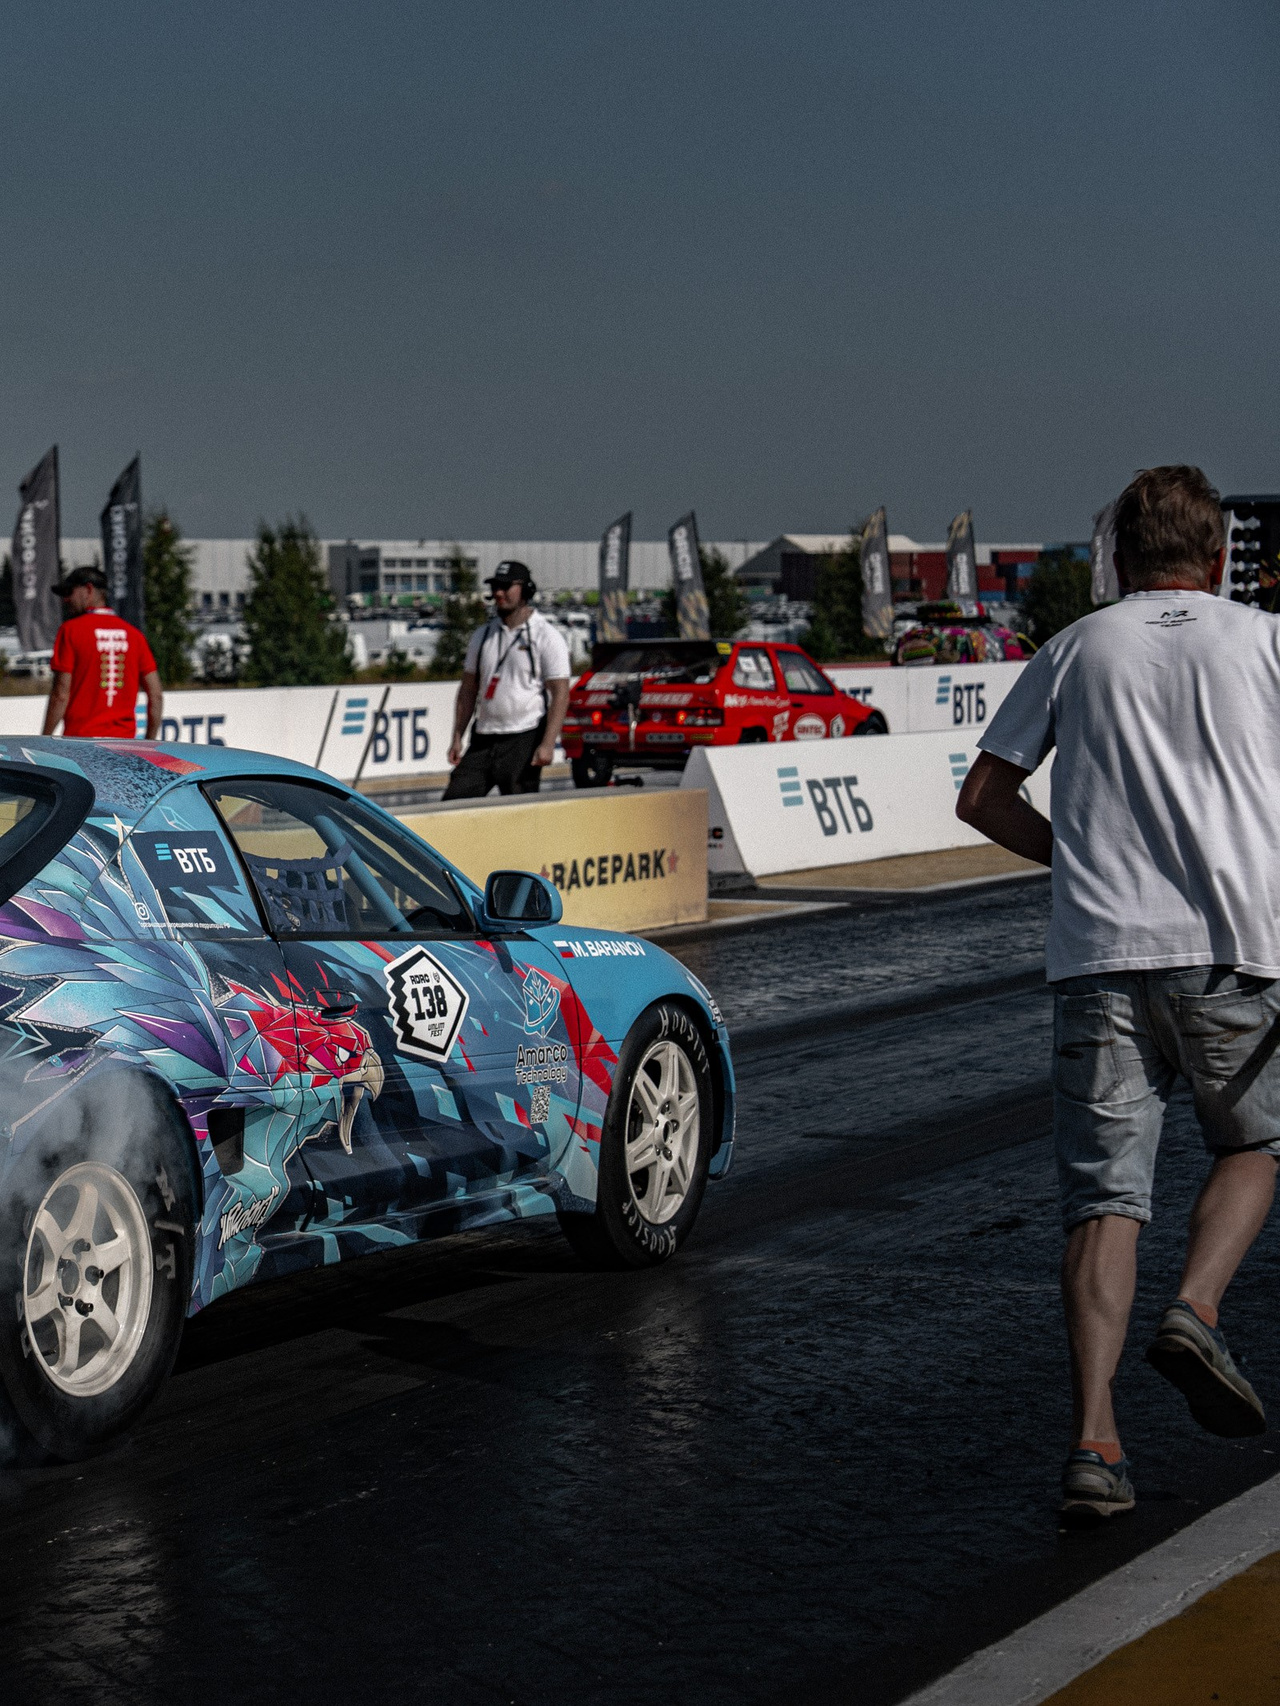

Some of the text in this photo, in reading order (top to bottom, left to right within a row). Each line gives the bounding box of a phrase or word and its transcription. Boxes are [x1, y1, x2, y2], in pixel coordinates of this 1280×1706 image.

[953, 682, 986, 726] ВТБ
[372, 706, 430, 763] ВТБ
[805, 775, 873, 837] ВТБ
[172, 847, 217, 873] ВТБ
[552, 849, 666, 891] RACEPARK
[409, 973, 430, 985] RDRC
[410, 985, 448, 1021] 138
[430, 1029, 444, 1037] FEST
[515, 1043, 568, 1069] Amarco
[515, 1065, 568, 1085] Technology
